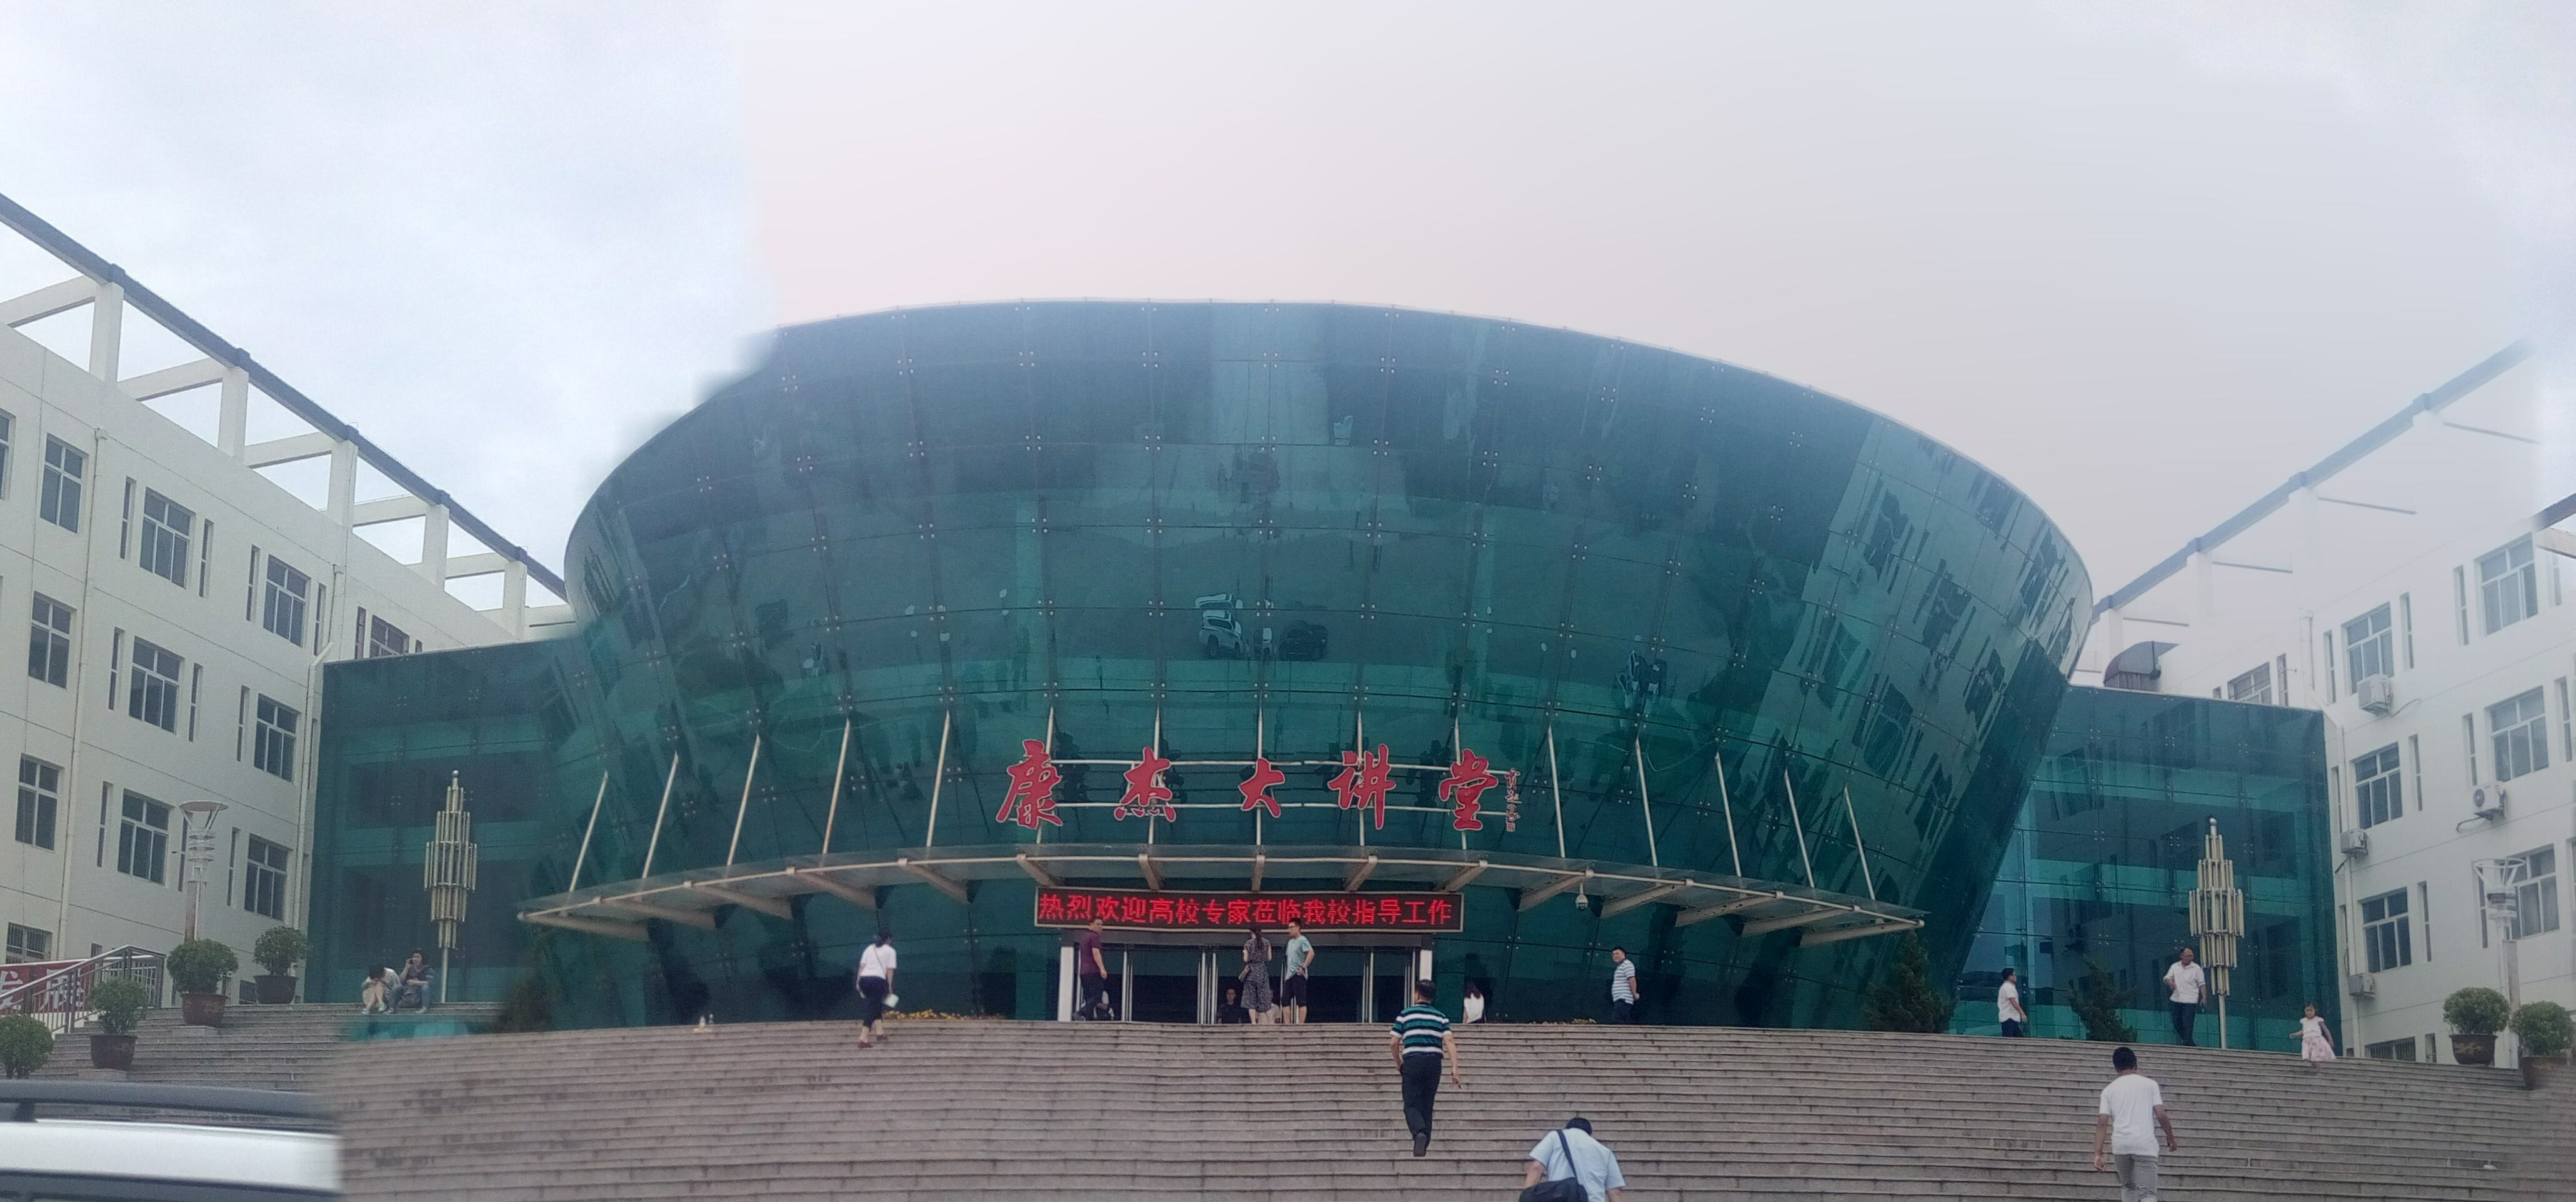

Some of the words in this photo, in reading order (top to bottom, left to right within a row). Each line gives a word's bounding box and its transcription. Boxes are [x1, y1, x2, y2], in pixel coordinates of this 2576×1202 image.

[996, 739, 1499, 831] 康杰大讲堂
[1039, 893, 1452, 925] 热烈欢迎高校专家莅临我校指导工作
